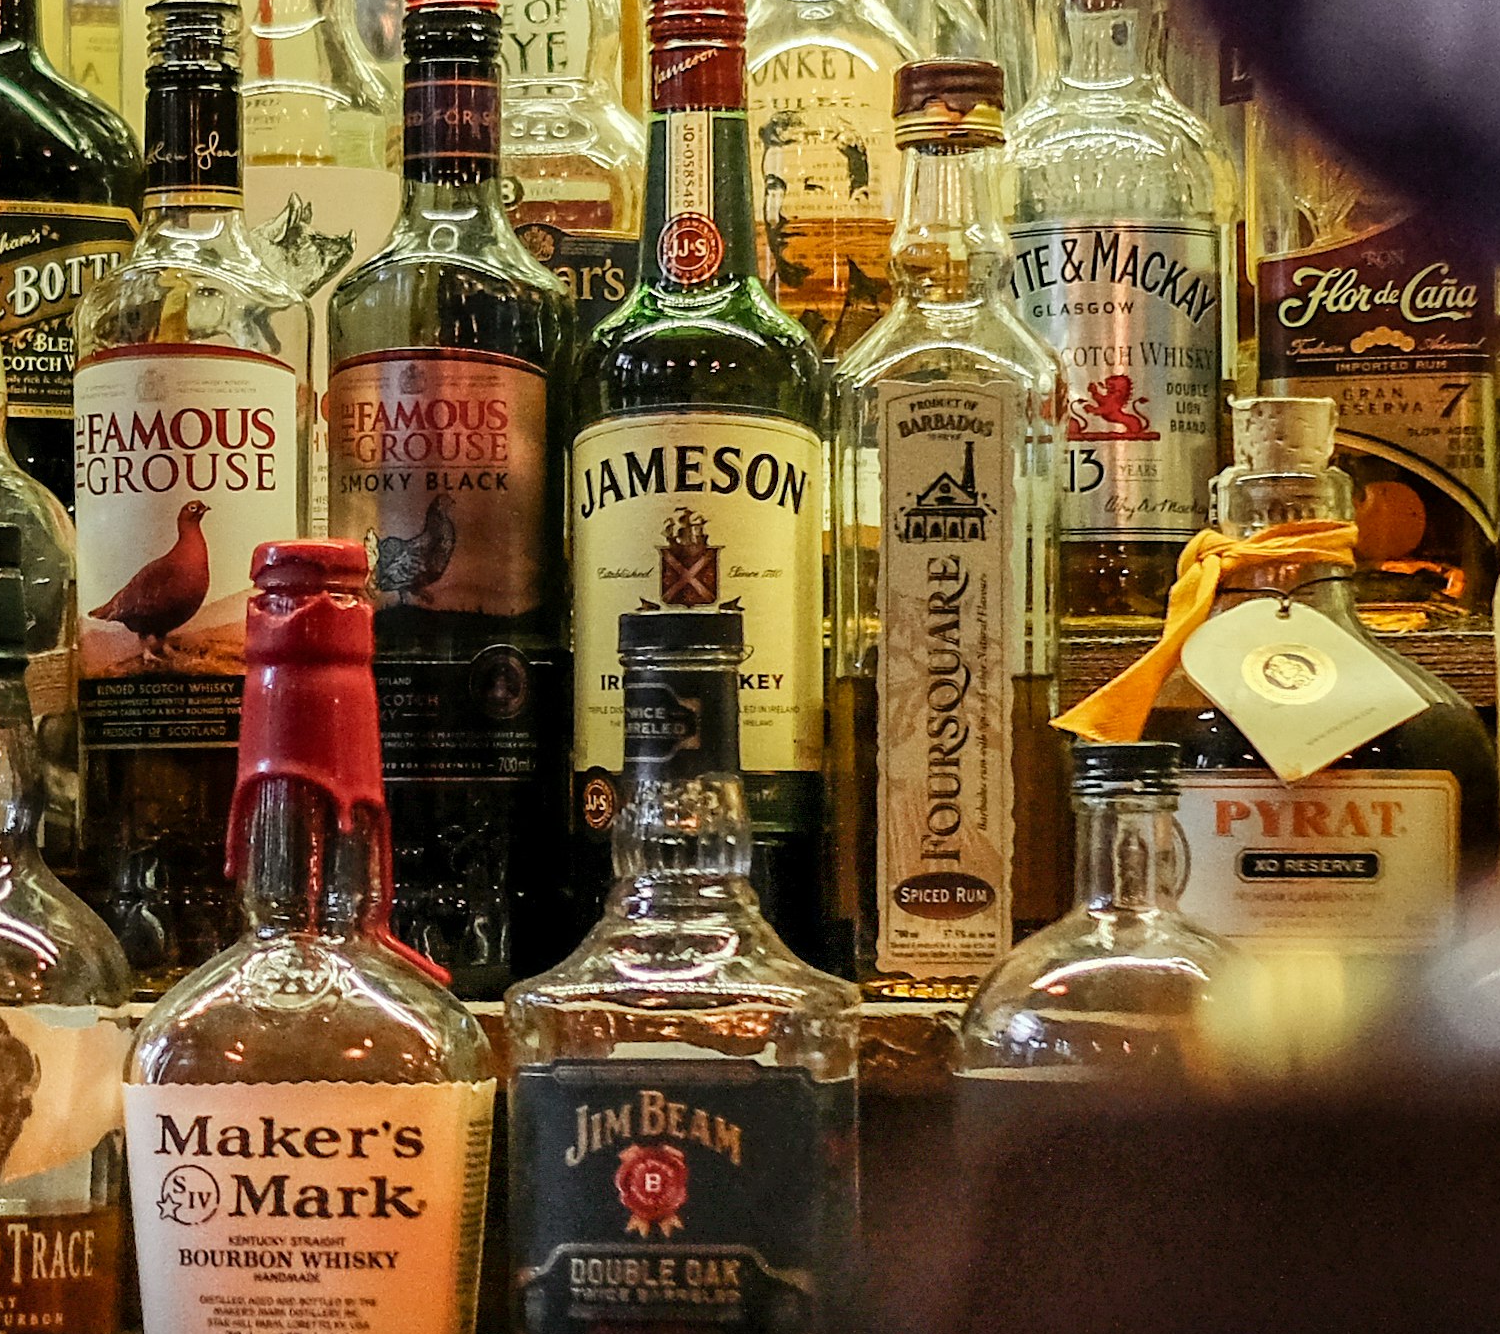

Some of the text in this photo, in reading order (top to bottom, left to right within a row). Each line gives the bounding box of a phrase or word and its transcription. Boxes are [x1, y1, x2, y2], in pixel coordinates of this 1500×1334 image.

[653, 48, 719, 101] Jameson
[1061, 230, 1217, 324] & MACKAY
[1278, 262, 1478, 328] Flor de Caña
[1032, 301, 1135, 318] GLASGOW
[2, 355, 62, 373] COTCH
[1335, 359, 1448, 373] IMPORTED RUM
[1166, 381, 1209, 398] DOUBLE
[1439, 382, 1472, 419] 7
[355, 398, 509, 433] FAMOUS
[909, 398, 979, 413] PRODUCT OF
[1176, 399, 1202, 416] LION
[1339, 401, 1423, 416] ESERVA
[87, 407, 277, 455] FAMOUS
[896, 413, 996, 438] BARBADOS
[1170, 420, 1207, 435] BRAND
[355, 431, 509, 464] GROUSE
[87, 452, 277, 496] GROUSE
[580, 444, 807, 520] JAMESON
[1067, 448, 1105, 494] 13
[340, 472, 509, 494] SMOKY BLACK
[96, 682, 235, 696] BLENDED SCOTCH WHISKY
[920, 554, 971, 864] FOURSQUARE
[168, 725, 227, 737] SCOTLAND
[1213, 799, 1404, 838] PYRAT
[1255, 859, 1367, 873] XO RESERVE
[900, 886, 988, 904] SPICED RUM
[154, 1113, 426, 1159] Maker's
[565, 1089, 744, 1167] JIM BEAM
[644, 1172, 661, 1192] B
[187, 1191, 212, 1210] IV
[228, 1174, 421, 1219] Mark
[228, 1235, 347, 1247] KENTUCKY STRAIGHT
[7, 1222, 96, 1284] TRACE
[178, 1248, 400, 1269] BOURBON WHISKY
[253, 1272, 321, 1283] HANDMADE
[569, 1257, 742, 1287] DOUBLE OAK
